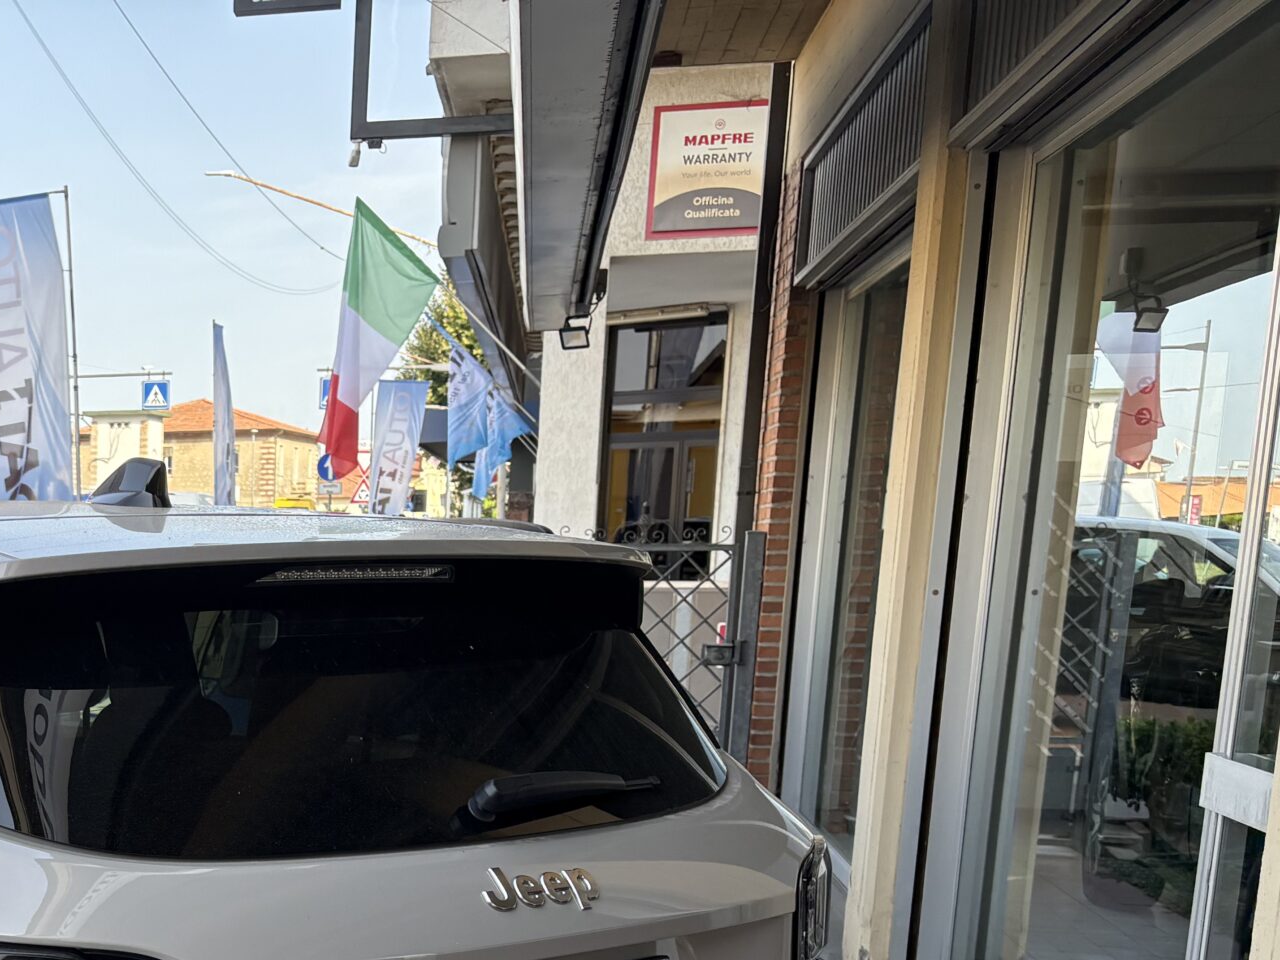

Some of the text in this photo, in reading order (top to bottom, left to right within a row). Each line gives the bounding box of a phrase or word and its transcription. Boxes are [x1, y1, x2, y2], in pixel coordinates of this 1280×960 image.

[683, 132, 755, 147] MAPFRE
[682, 151, 753, 165] WARRANTY
[681, 171, 699, 179] Your
[714, 169, 728, 177] Our
[730, 168, 752, 177] world
[693, 195, 734, 206] Officina
[684, 207, 741, 219] Qualificata
[480, 866, 600, 912] Jeep
